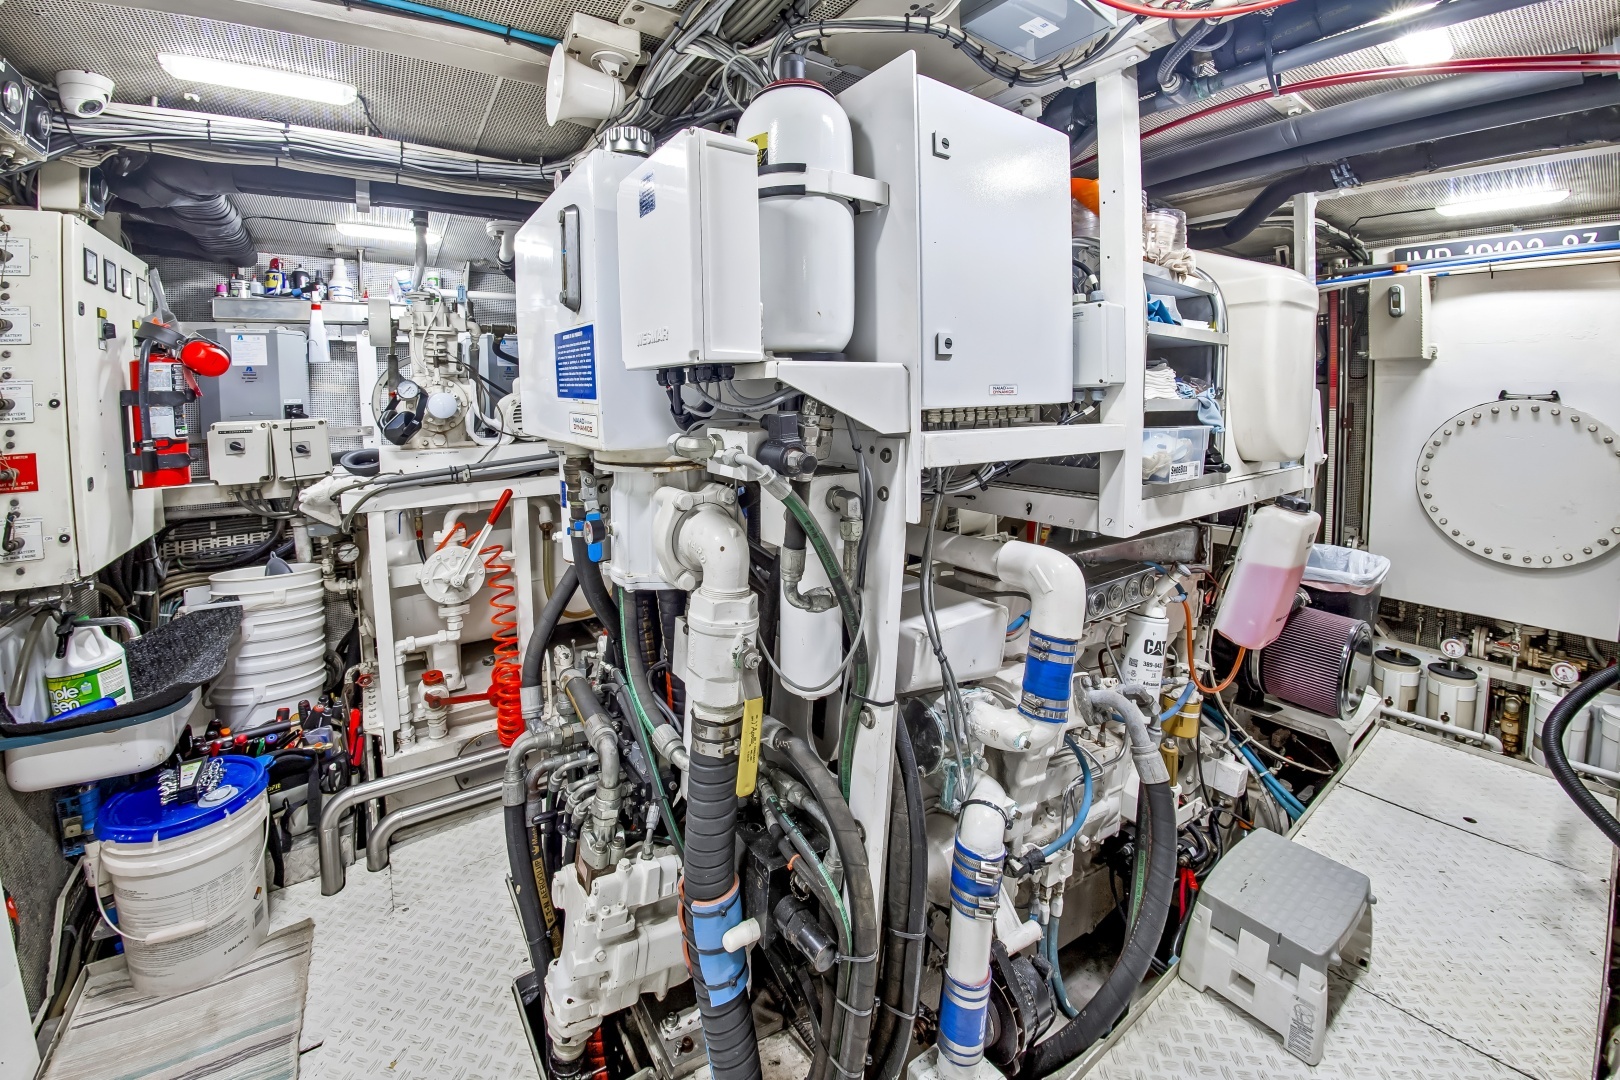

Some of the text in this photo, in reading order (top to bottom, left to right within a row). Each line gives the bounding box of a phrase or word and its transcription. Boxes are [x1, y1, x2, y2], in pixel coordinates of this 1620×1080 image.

[573, 423, 593, 433] DYNAMICS
[1143, 638, 1167, 656] CAT
[49, 686, 80, 703] mple
[52, 700, 80, 714] een
[534, 860, 550, 899] AEROQUIP
